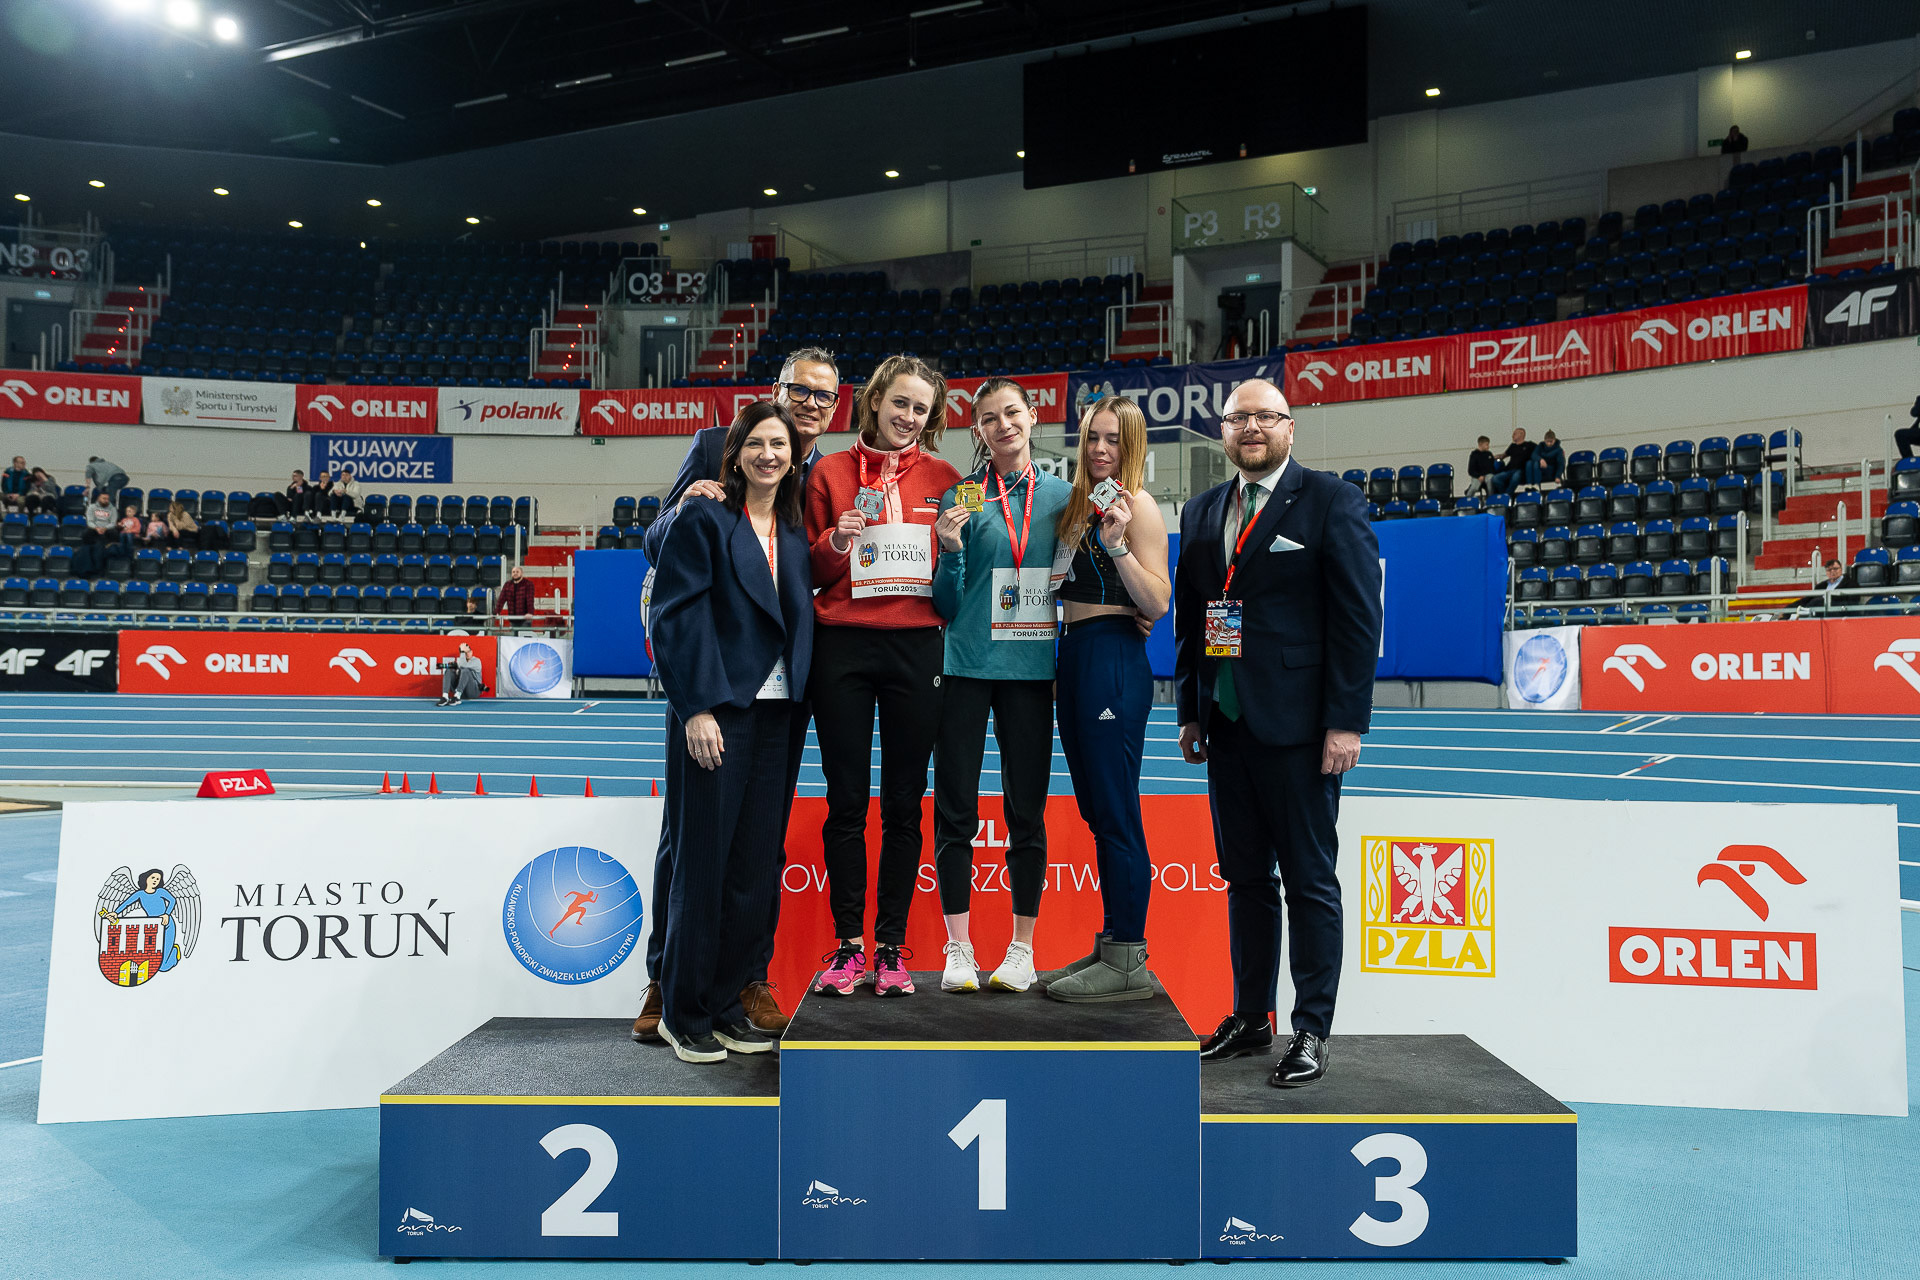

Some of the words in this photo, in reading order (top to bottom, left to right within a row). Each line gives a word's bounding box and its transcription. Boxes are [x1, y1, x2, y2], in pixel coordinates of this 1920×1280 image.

[1184, 210, 1218, 238] P3
[1244, 202, 1281, 230] R3
[0, 243, 35, 268] N3
[629, 272, 663, 295] O3
[676, 272, 708, 295] P3
[1824, 285, 1897, 327] 4F
[1687, 306, 1791, 341] ORLEN
[1470, 329, 1590, 369] PZLA
[1345, 355, 1431, 383] ORLEN
[45, 386, 129, 408] ORLEN
[196, 390, 258, 401] Ministerstwo
[1121, 365, 1274, 422] TORU
[196, 401, 227, 412] Sportu
[235, 403, 278, 414] Turystyki
[351, 399, 427, 418] ORLEN
[480, 401, 565, 422] polanik
[632, 401, 704, 420] ORLEN
[328, 439, 418, 458] KUJAWY
[328, 460, 434, 479] POMORZE
[1035, 457, 1068, 482] P1
[882, 549, 926, 562] TORUŃ
[873, 584, 899, 593] TORUŃ
[900, 585, 917, 593] 2025
[1012, 629, 1037, 637] TORUŃ
[0, 648, 45, 675] 4F
[55, 650, 110, 676] 4F
[1212, 647, 1224, 655] VIP
[205, 653, 289, 674] ORLEN
[394, 656, 456, 676] ORL
[1691, 652, 1810, 681] ORLEN
[219, 776, 267, 792] PZLA
[234, 881, 404, 908] MIASTO
[220, 898, 455, 962] TORUŃ
[507, 883, 539, 970] KUJAWSKO-POMORSKI
[537, 964, 574, 981] ZWIĄZEK
[576, 962, 609, 981] LEKKIEJ
[608, 933, 635, 967] ATLETYKI
[1367, 928, 1488, 970] PZLA
[1618, 934, 1804, 982] ORLEN
[947, 1099, 1006, 1210] 1
[539, 1123, 618, 1236] 2
[1349, 1132, 1429, 1246] 3
[802, 1195, 867, 1205] arena
[397, 1223, 462, 1233] arena
[1220, 1232, 1284, 1242] arena
